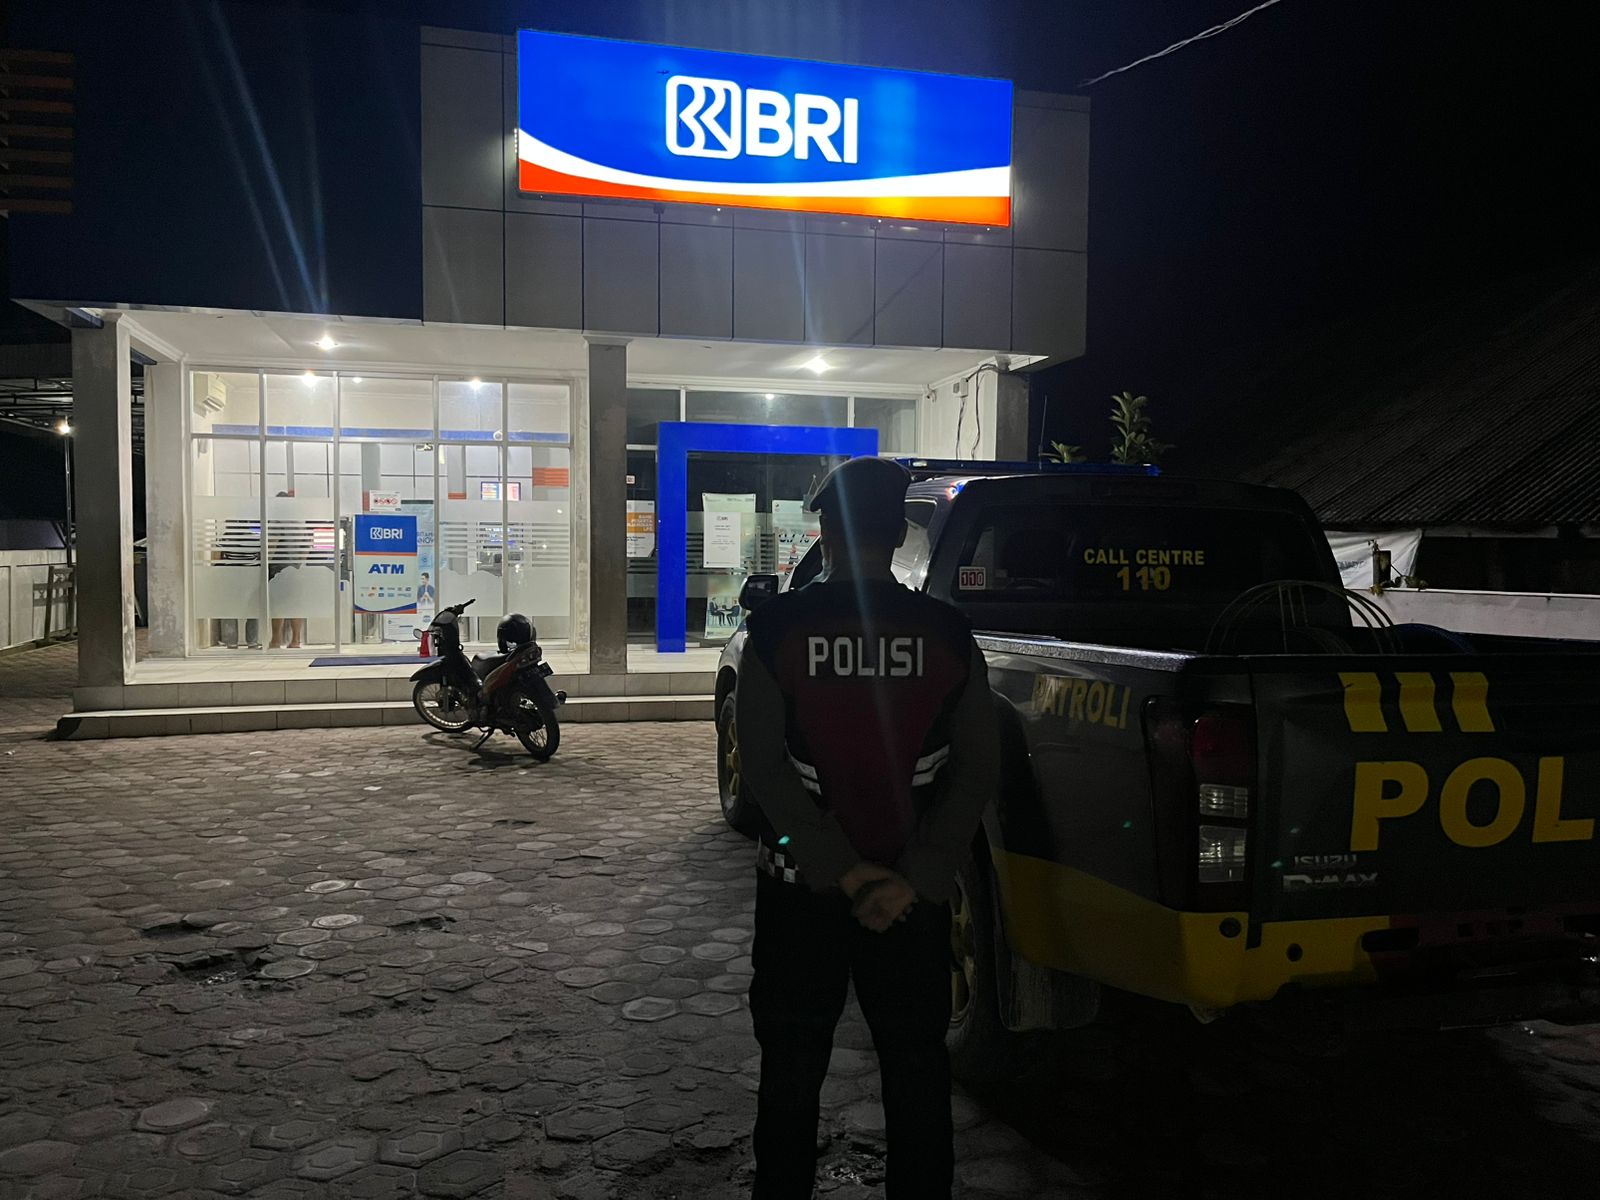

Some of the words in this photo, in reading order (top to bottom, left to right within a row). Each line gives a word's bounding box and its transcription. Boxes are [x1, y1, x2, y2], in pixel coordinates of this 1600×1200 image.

[746, 88, 858, 164] BRI
[383, 528, 403, 539] BRI
[368, 563, 405, 574] ATM
[1083, 547, 1129, 565] CALL
[1135, 548, 1206, 566] CENTRE
[961, 571, 985, 586] 110
[1116, 565, 1172, 592] 110
[808, 636, 923, 676] POLISI
[1031, 673, 1132, 730] PATROLI
[1350, 756, 1596, 852] POL
